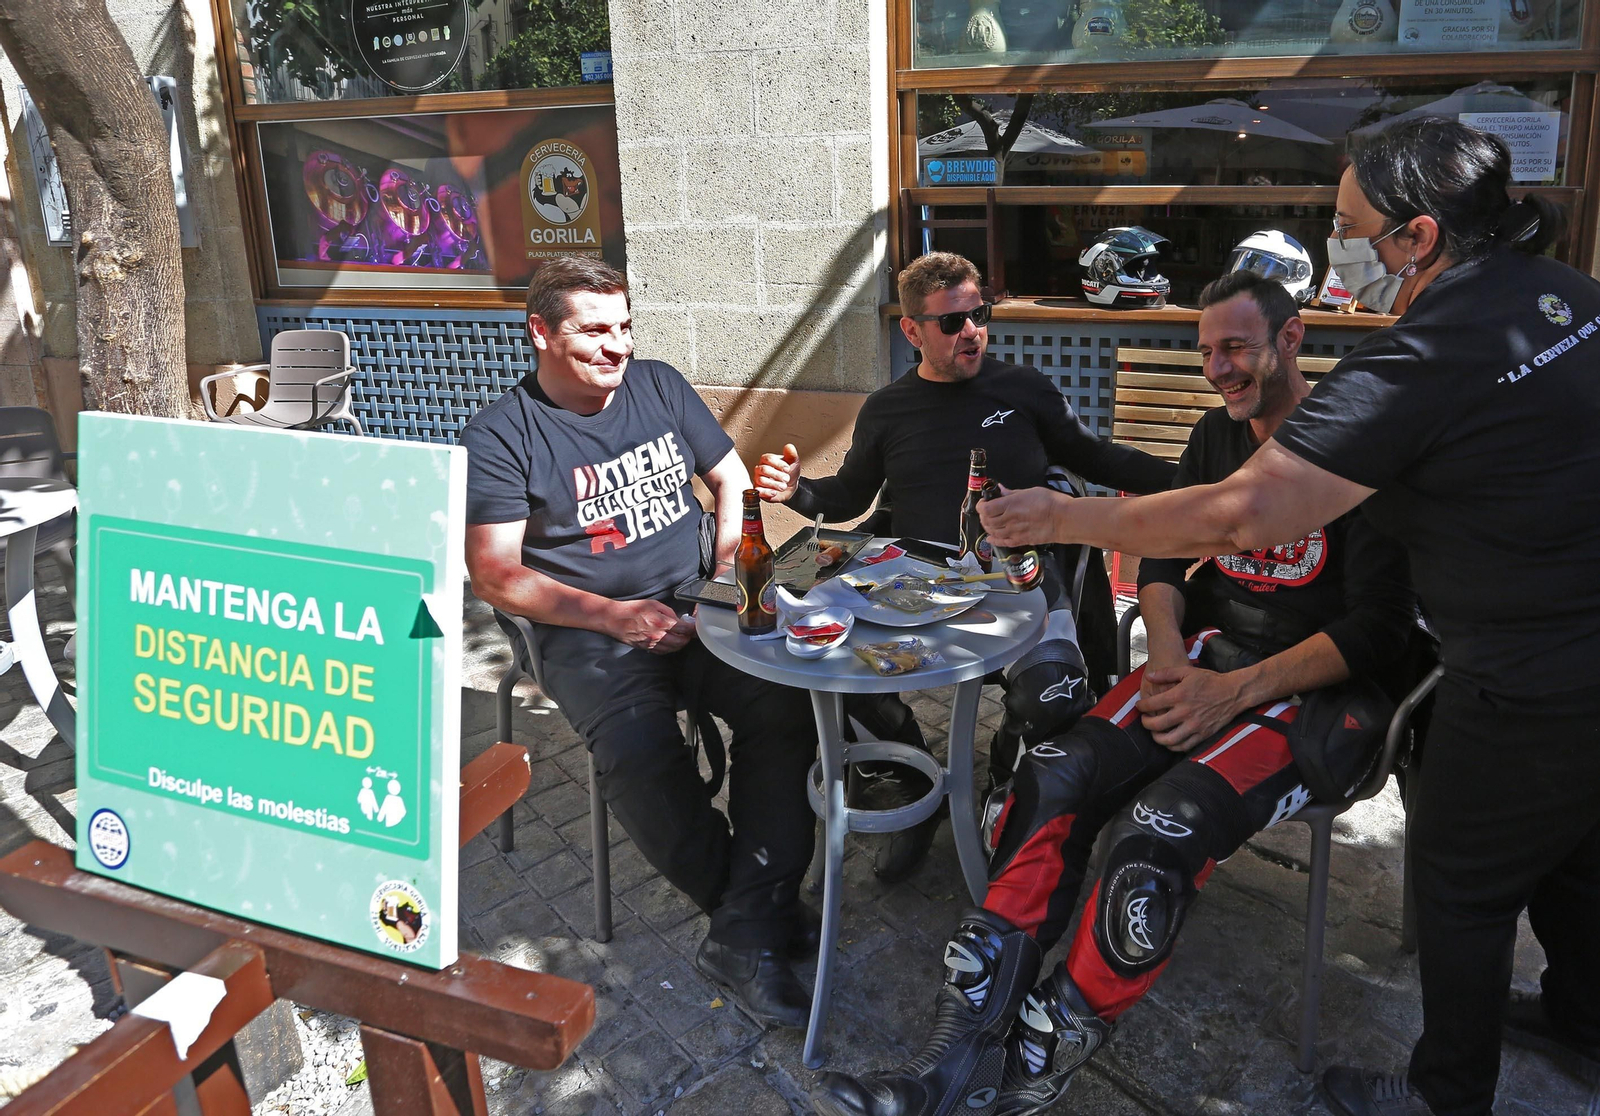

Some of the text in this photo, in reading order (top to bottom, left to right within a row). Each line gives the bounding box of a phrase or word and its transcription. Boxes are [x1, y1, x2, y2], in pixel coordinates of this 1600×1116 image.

[366, 3, 393, 12] NUESTRA
[392, 13, 424, 23] PERSONAL
[1476, 116, 1515, 124] CERVECERÍA
[1523, 123, 1550, 131] MÁXIMO
[529, 142, 587, 167] CERVECERÍA
[946, 160, 995, 173] BREWDOG
[946, 173, 980, 182] DISPONIBLE
[530, 228, 596, 244] GORILA
[1533, 334, 1580, 367] CERVEZA
[1577, 321, 1598, 340] QUE
[593, 431, 684, 496] XTREME
[130, 568, 385, 646] MANTENGA LA
[134, 623, 375, 702] DISTANCIA DE
[133, 673, 375, 760] SEGURIDAD
[148, 766, 351, 834] Disculpe las molestias
[1108, 875, 1120, 897] VISION
[1118, 867, 1125, 875] OF
[1139, 863, 1165, 876] FUTURE
